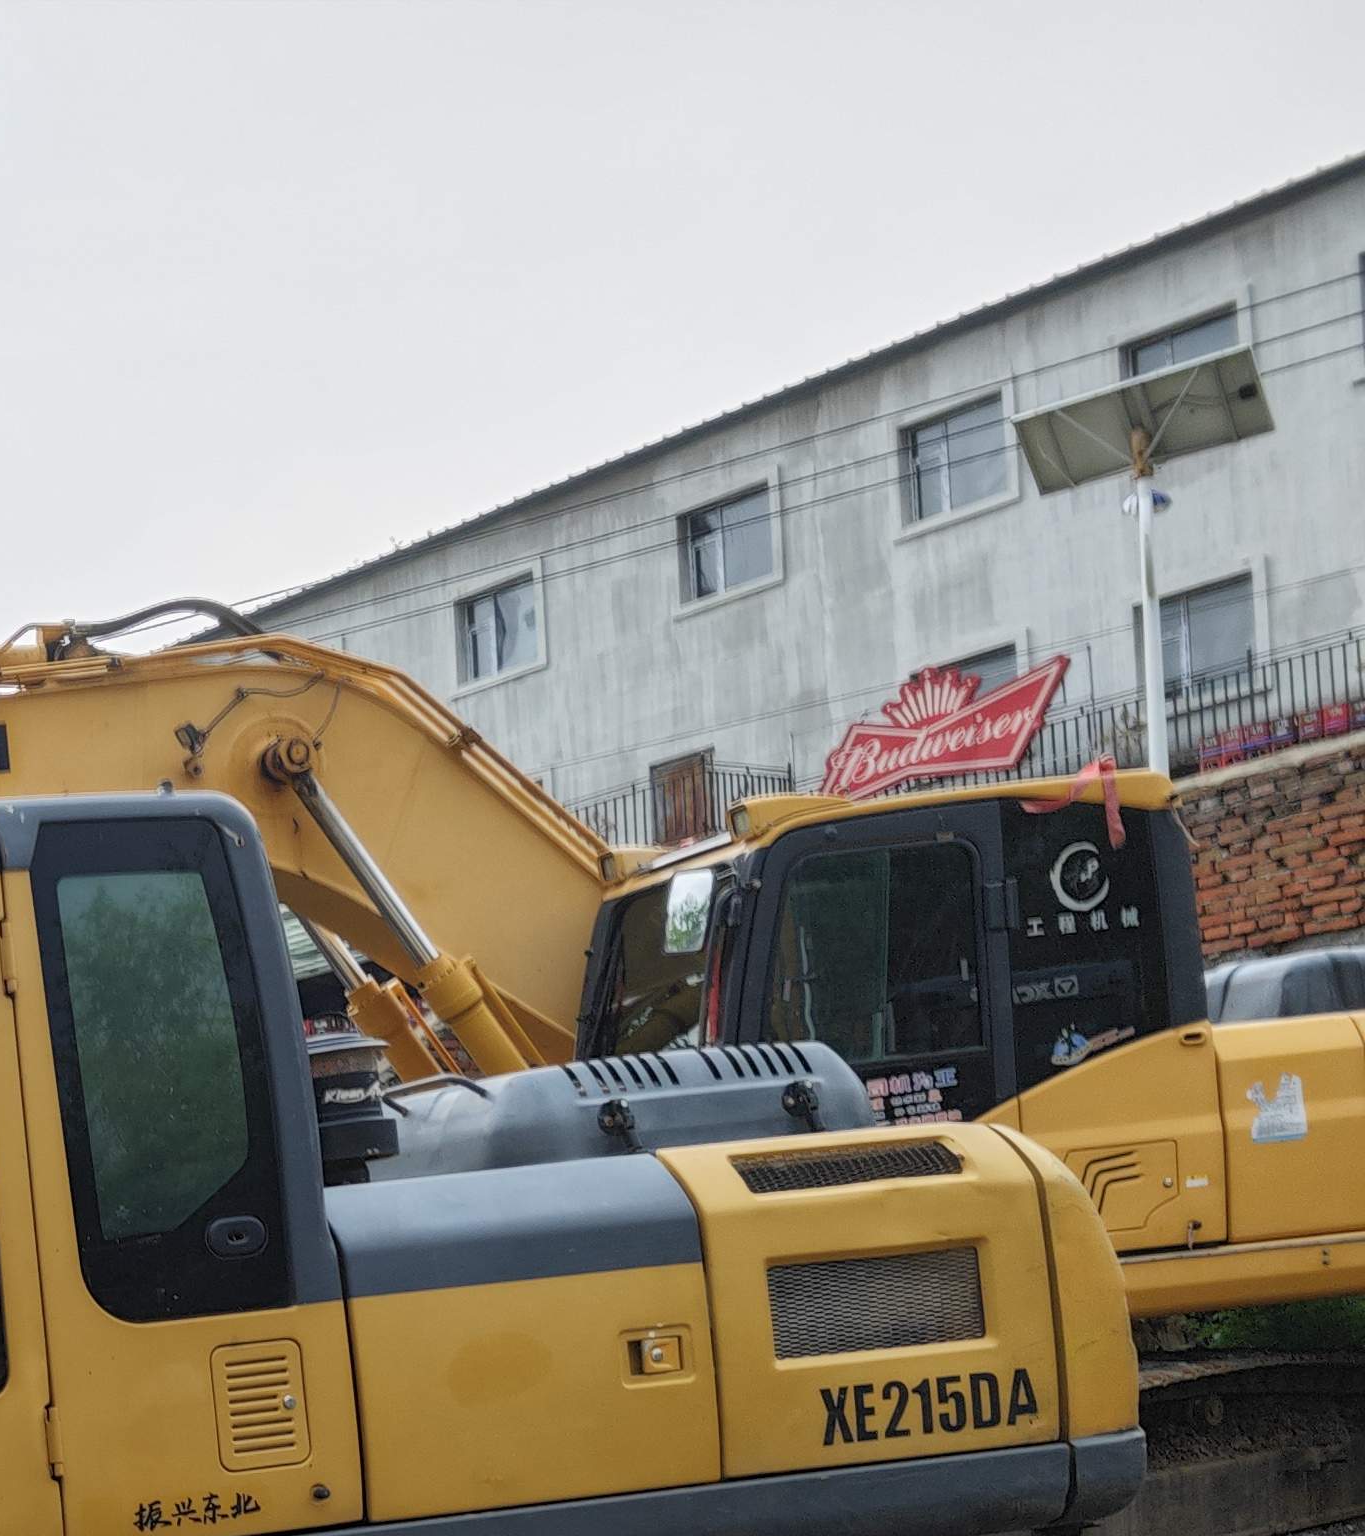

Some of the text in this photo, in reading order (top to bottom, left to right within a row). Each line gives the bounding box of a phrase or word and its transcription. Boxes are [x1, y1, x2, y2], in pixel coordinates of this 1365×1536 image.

[829, 704, 1037, 796] Budweiser
[819, 1367, 1039, 1447] XE215DA
[132, 1491, 262, 1533] 振兴东北
